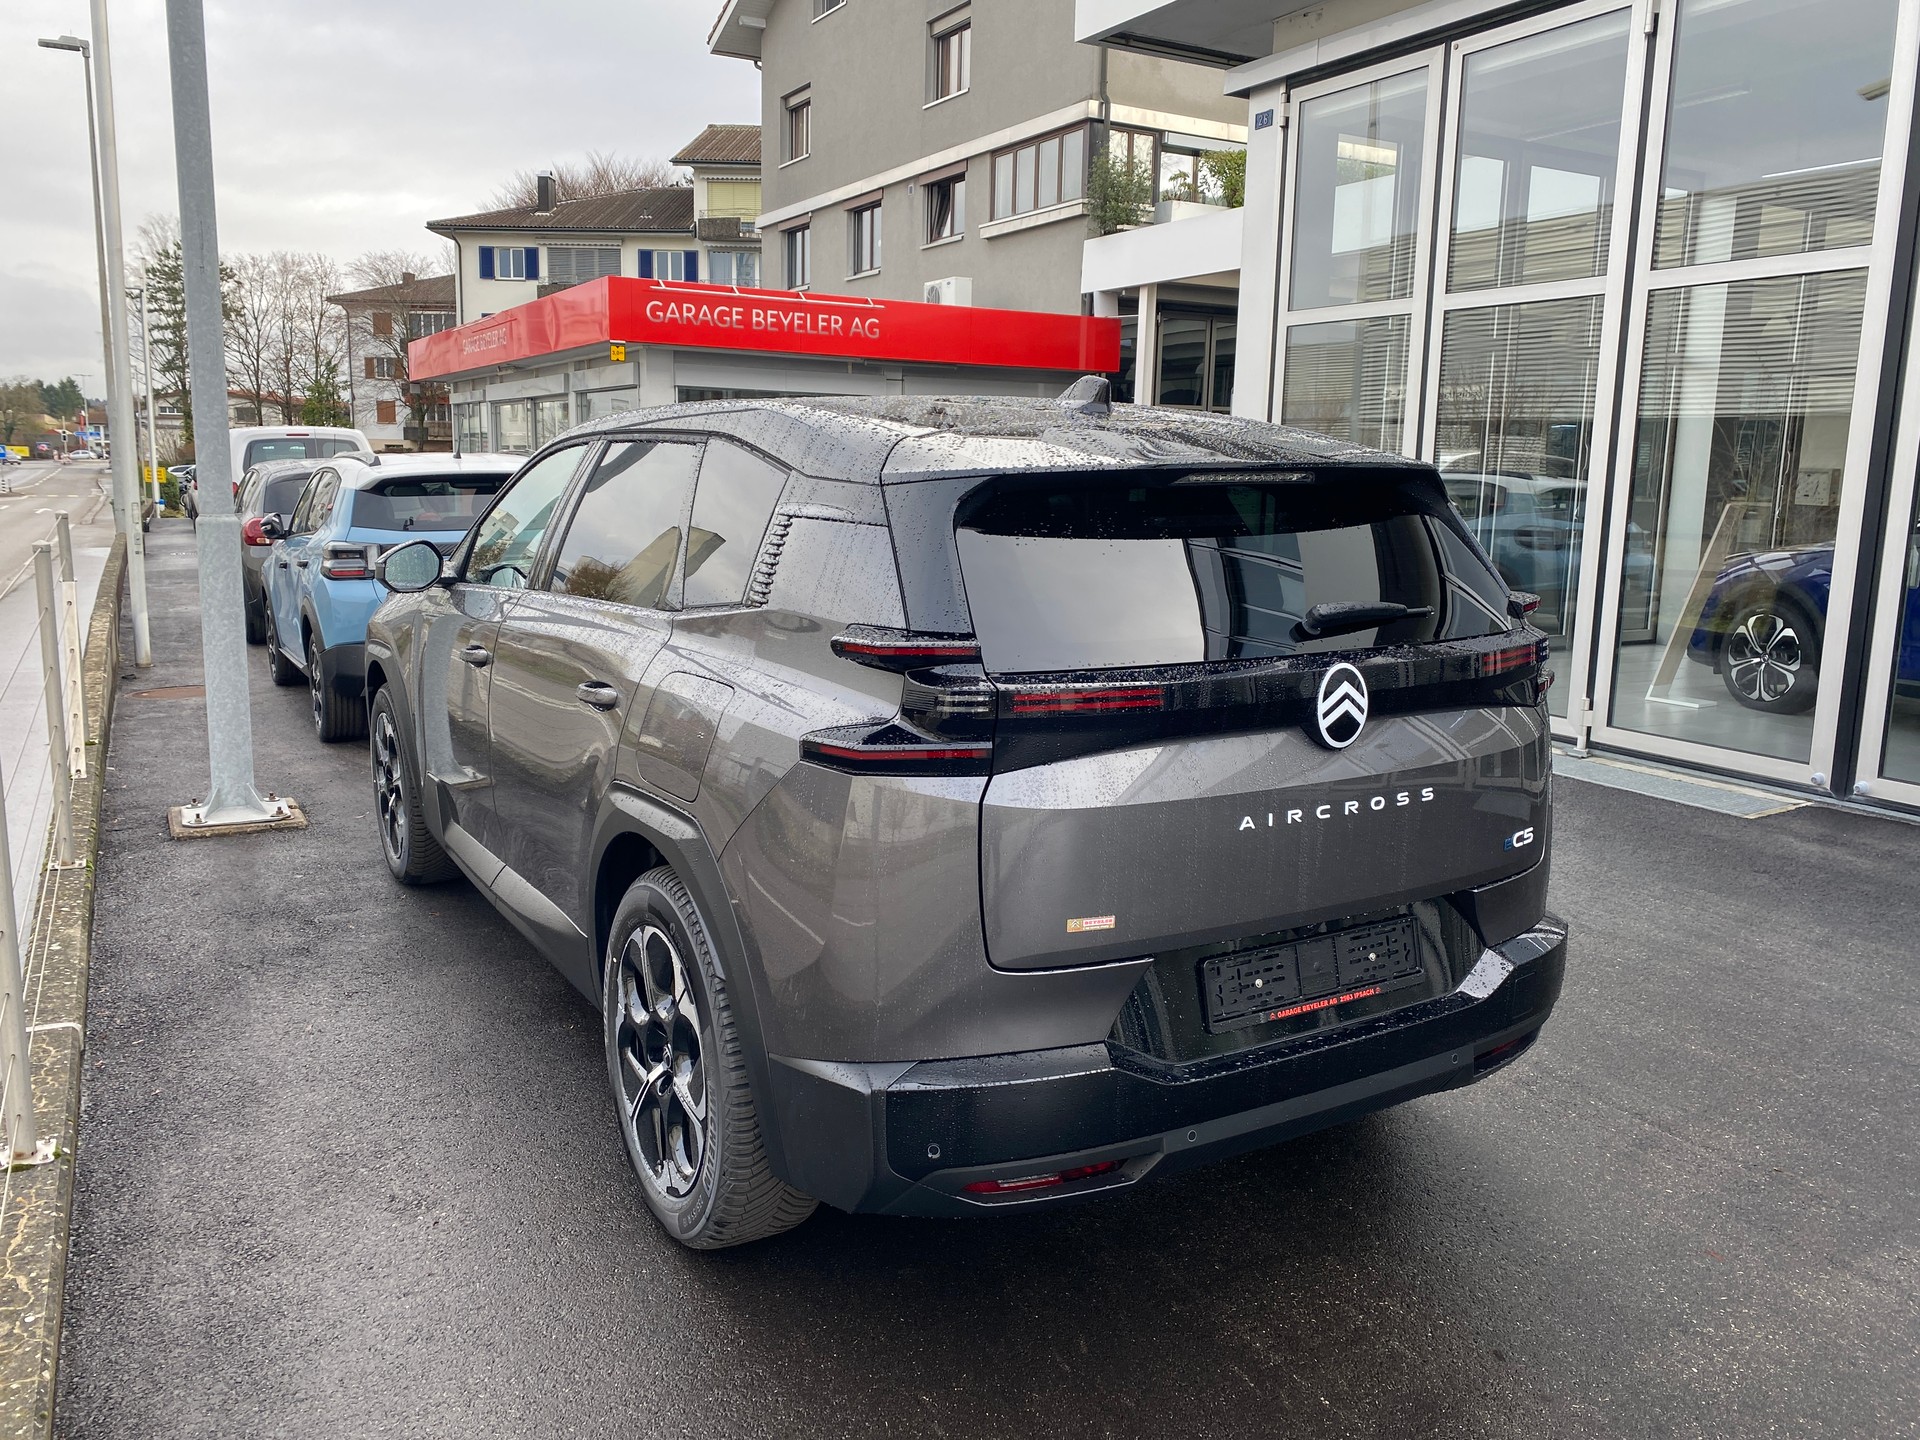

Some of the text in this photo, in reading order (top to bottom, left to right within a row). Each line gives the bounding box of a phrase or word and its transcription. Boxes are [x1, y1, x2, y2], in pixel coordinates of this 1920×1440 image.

[1258, 113, 1268, 126] 26
[645, 300, 880, 339] GARAGE BEYELER AG
[462, 335, 480, 355] GARAGE
[1239, 787, 1434, 831] AIRCROSS
[1277, 1006, 1302, 1019] GARAGE
[1302, 1000, 1329, 1012] BEYELER
[1329, 997, 1338, 1005] AG
[1354, 988, 1375, 999] IPSACH
[703, 1083, 718, 1193] MICHELIN
